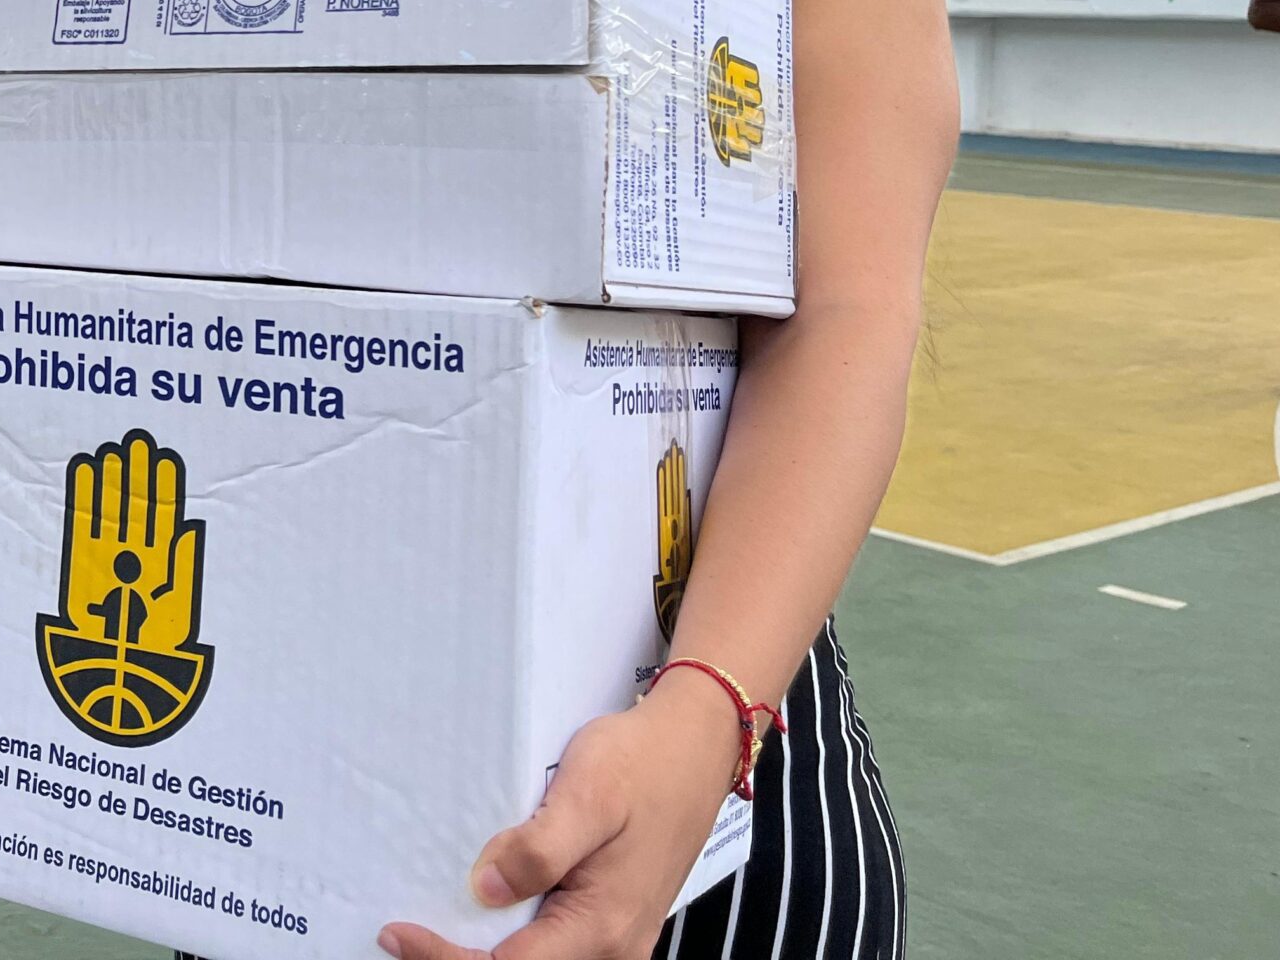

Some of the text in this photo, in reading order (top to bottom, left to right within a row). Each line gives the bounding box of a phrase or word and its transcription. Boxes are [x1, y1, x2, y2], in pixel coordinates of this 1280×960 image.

[83, 29, 119, 38] C011320
[775, 13, 783, 122] Prohibida
[637, 203, 645, 269] Colombia
[664, 197, 672, 272] Desastres
[672, 216, 680, 273] Gestión
[13, 301, 194, 349] Humanitaria
[204, 316, 244, 354] de
[254, 319, 465, 375] Emergencia
[584, 337, 633, 368] Asistencia
[635, 340, 685, 369] Humanitaria
[686, 343, 697, 368] de
[150, 367, 203, 404] su
[218, 368, 346, 420] venta
[612, 381, 674, 417] Prohibida
[691, 382, 721, 412] venta
[16, 768, 92, 815] Riesgo
[97, 788, 127, 817] de
[133, 797, 253, 848] Desastres
[48, 741, 146, 788] Nacional
[152, 767, 182, 797] de
[187, 774, 285, 821] Gestión
[43, 845, 64, 868] es
[68, 851, 216, 913] responsabilidad
[220, 891, 246, 919] de
[250, 897, 310, 936] todos
